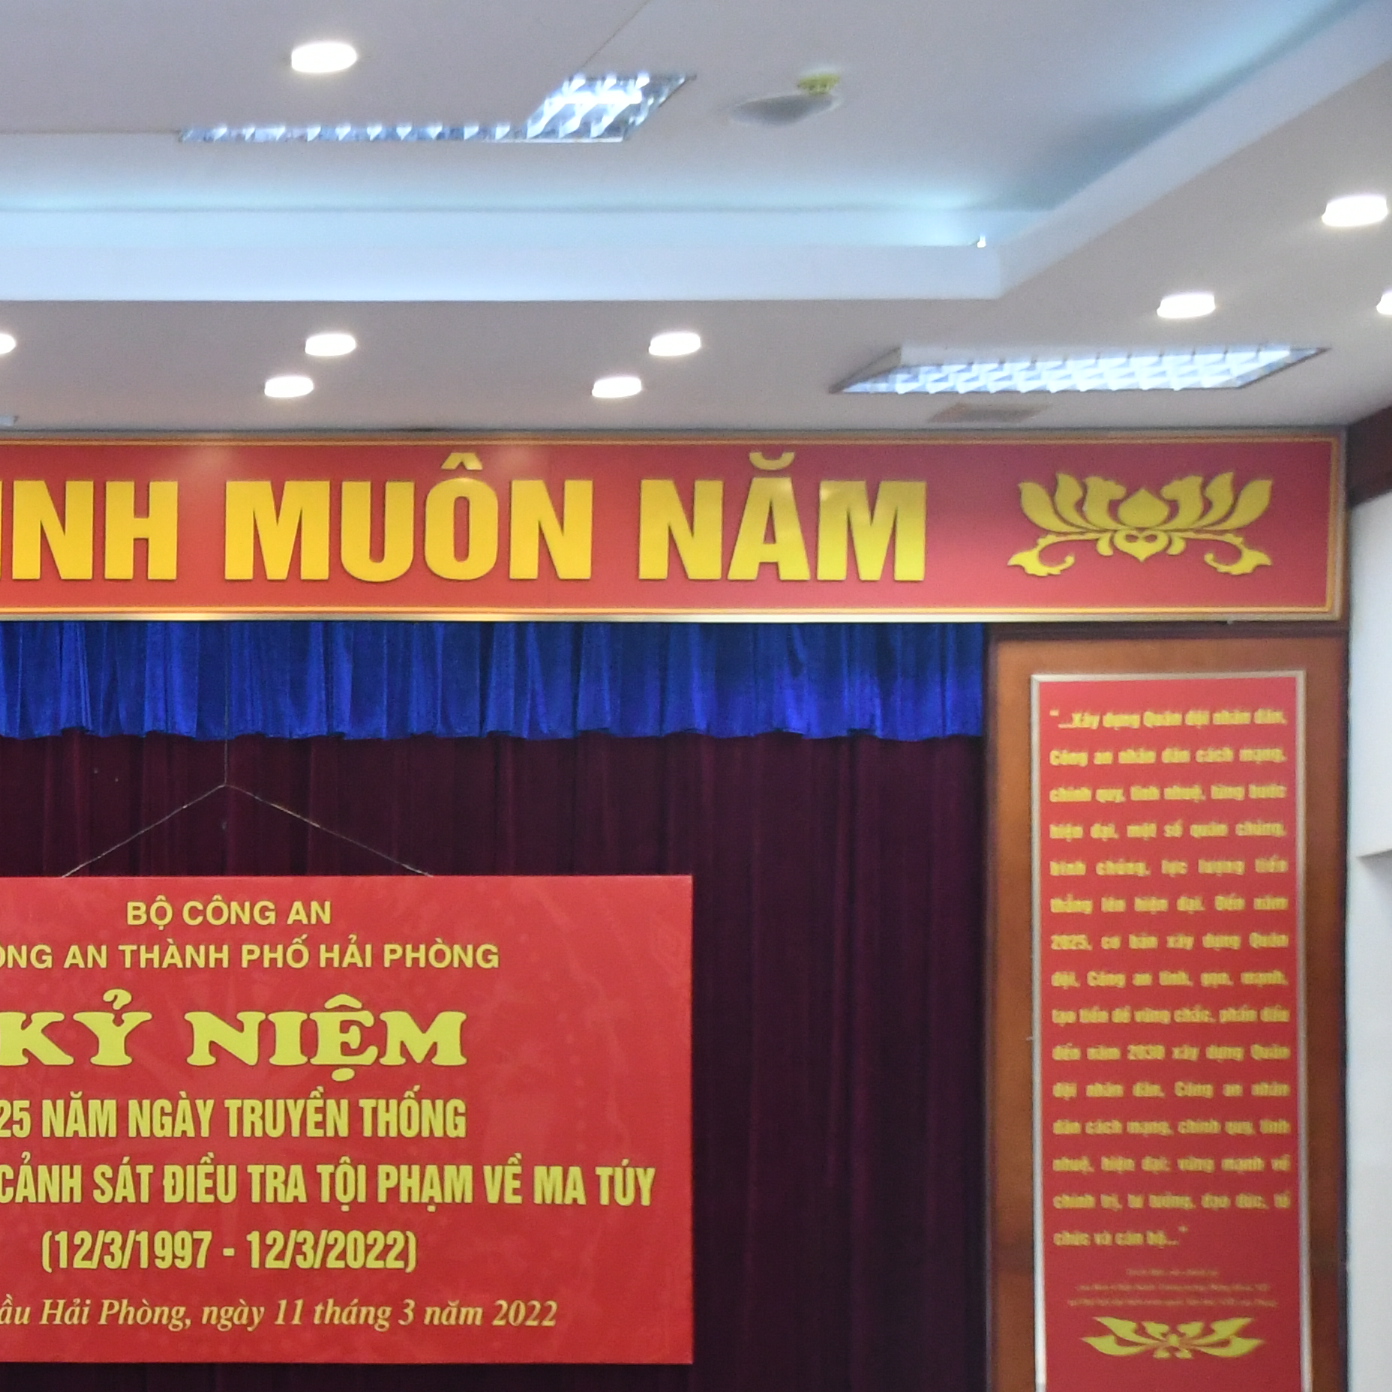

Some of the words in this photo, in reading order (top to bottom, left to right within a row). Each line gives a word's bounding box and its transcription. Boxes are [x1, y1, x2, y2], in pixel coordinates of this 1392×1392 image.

[225, 457, 593, 583] MUÔN
[638, 450, 929, 583] NĂM
[127, 894, 173, 931] BỘ
[182, 894, 276, 926] CÔNG
[286, 900, 331, 925] AN
[63, 944, 107, 969] AN
[118, 938, 229, 969] THÀNH
[241, 933, 310, 969] PHỐ
[319, 933, 372, 968] HẢI
[383, 937, 499, 969] PHÒNG
[184, 993, 467, 1082] NIỆM
[41, 1090, 117, 1138] NĂM
[128, 1090, 215, 1138] NGÀY
[224, 1085, 349, 1138] TRUYỀN
[358, 1084, 467, 1138] THỐNG
[92, 1156, 154, 1204] SÁT
[162, 1151, 237, 1204] ĐIỀU
[246, 1164, 308, 1203] TRA
[316, 1155, 367, 1212] TỘI
[377, 1164, 473, 1212] PHẠM
[483, 1152, 523, 1204] VỀ
[533, 1165, 587, 1205] MA
[595, 1158, 656, 1206] TÚY
[41, 1229, 213, 1273] (12/3/1997
[246, 1229, 417, 1273] 12/3/2022)
[39, 1297, 92, 1325] Hải
[98, 1298, 192, 1332] Phòng,
[201, 1298, 265, 1332] ngày
[274, 1298, 304, 1325] 11
[313, 1298, 393, 1332] tháng
[398, 1298, 416, 1326] 3
[423, 1300, 483, 1326] năm
[492, 1299, 558, 1327] 2022
